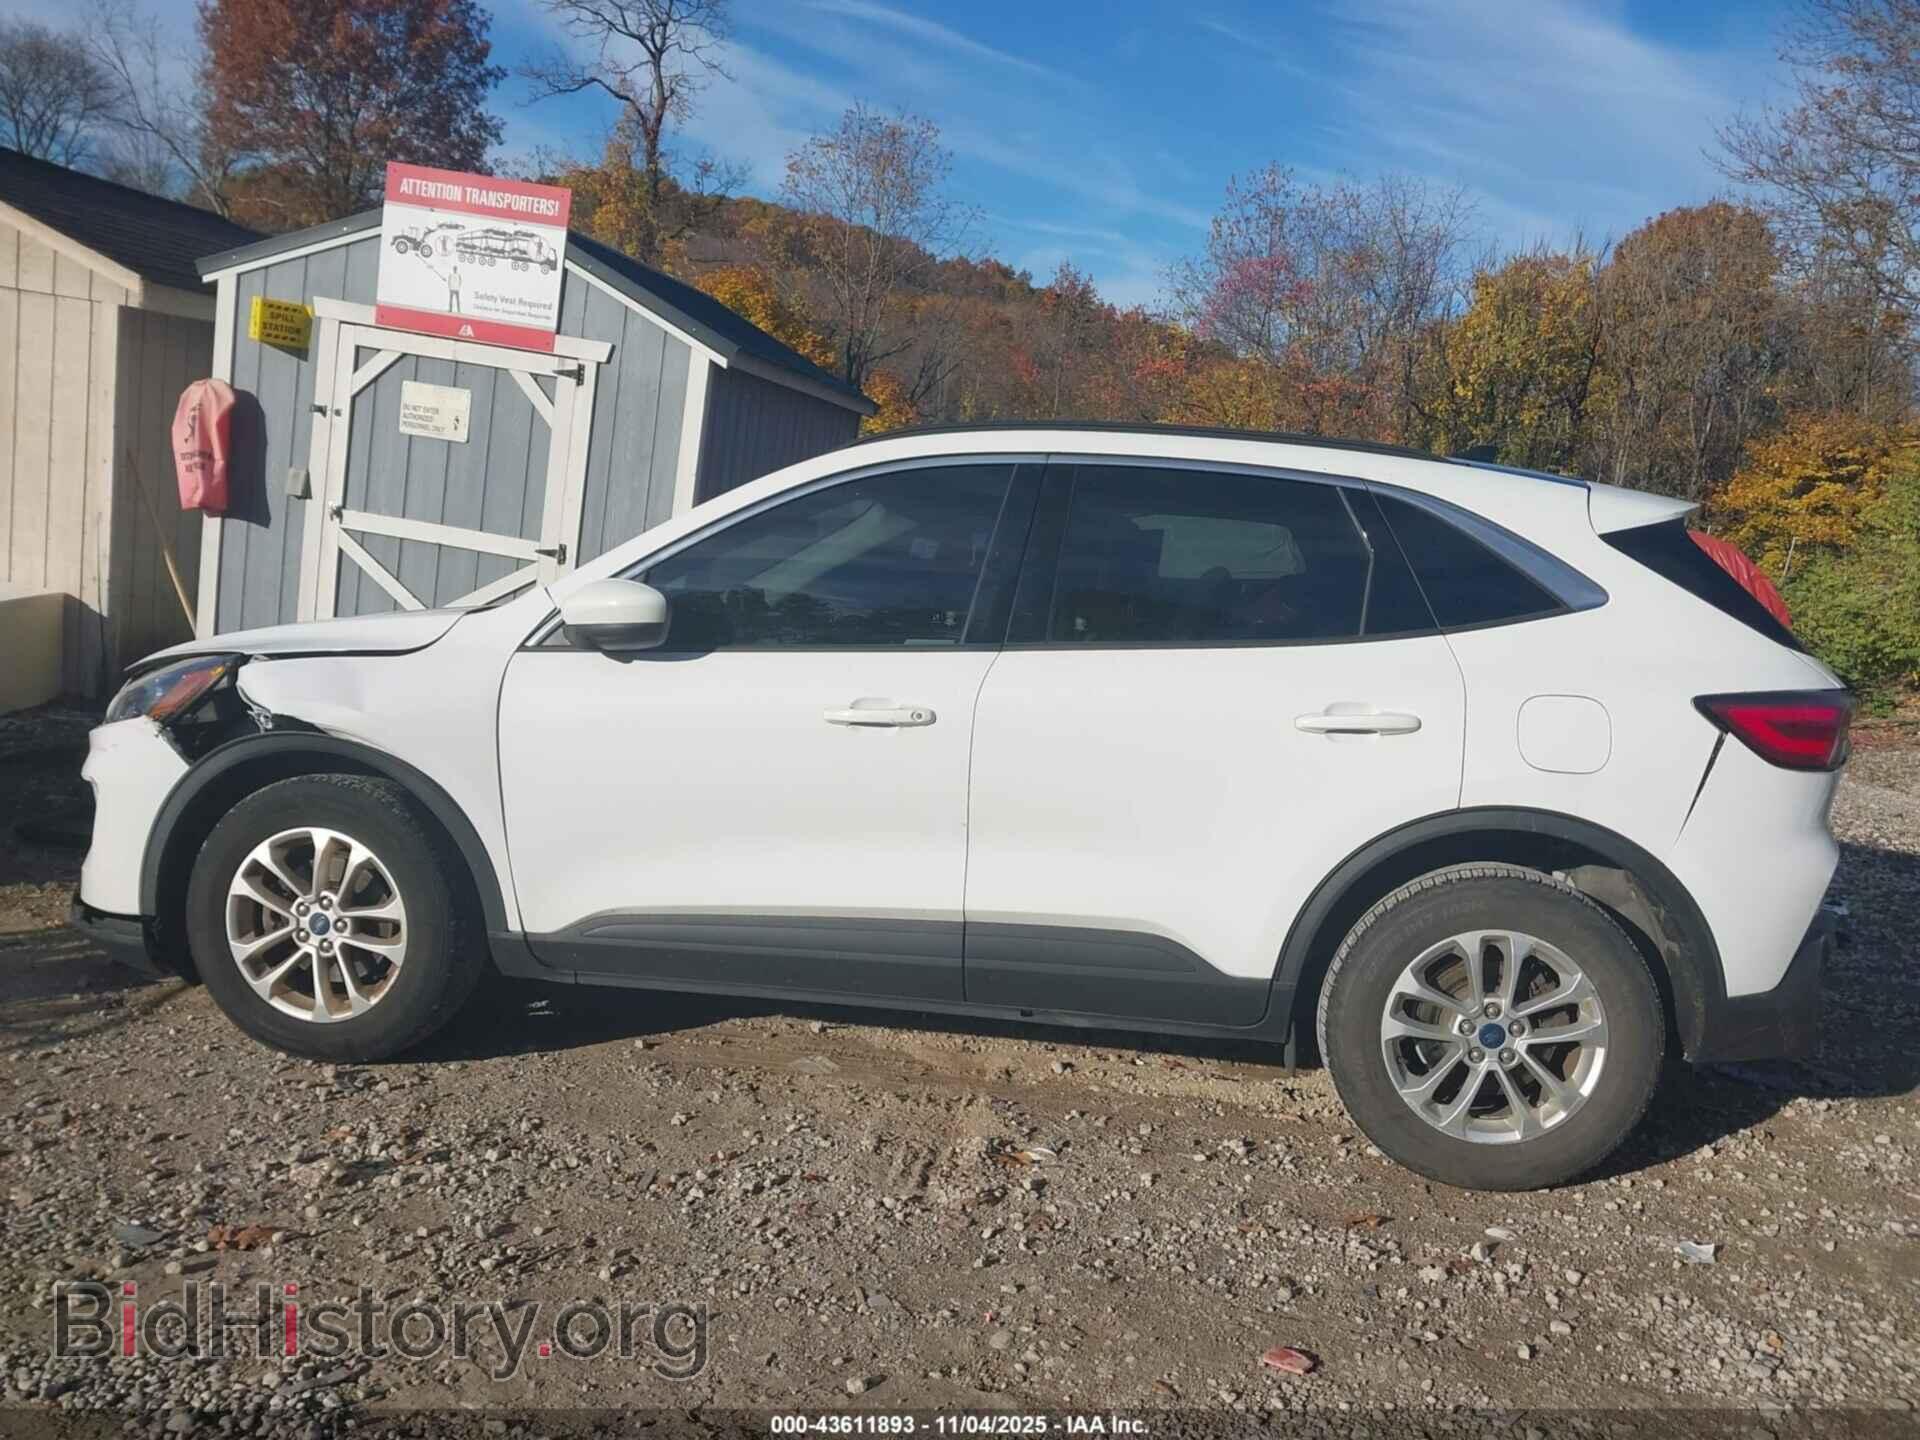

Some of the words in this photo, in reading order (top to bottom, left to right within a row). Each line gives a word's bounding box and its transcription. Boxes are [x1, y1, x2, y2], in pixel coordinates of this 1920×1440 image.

[400, 178, 463, 202] ATTENTION
[464, 187, 561, 217] TRANSPORTERS!
[270, 311, 296, 323] SPILL
[262, 321, 302, 336] STATION
